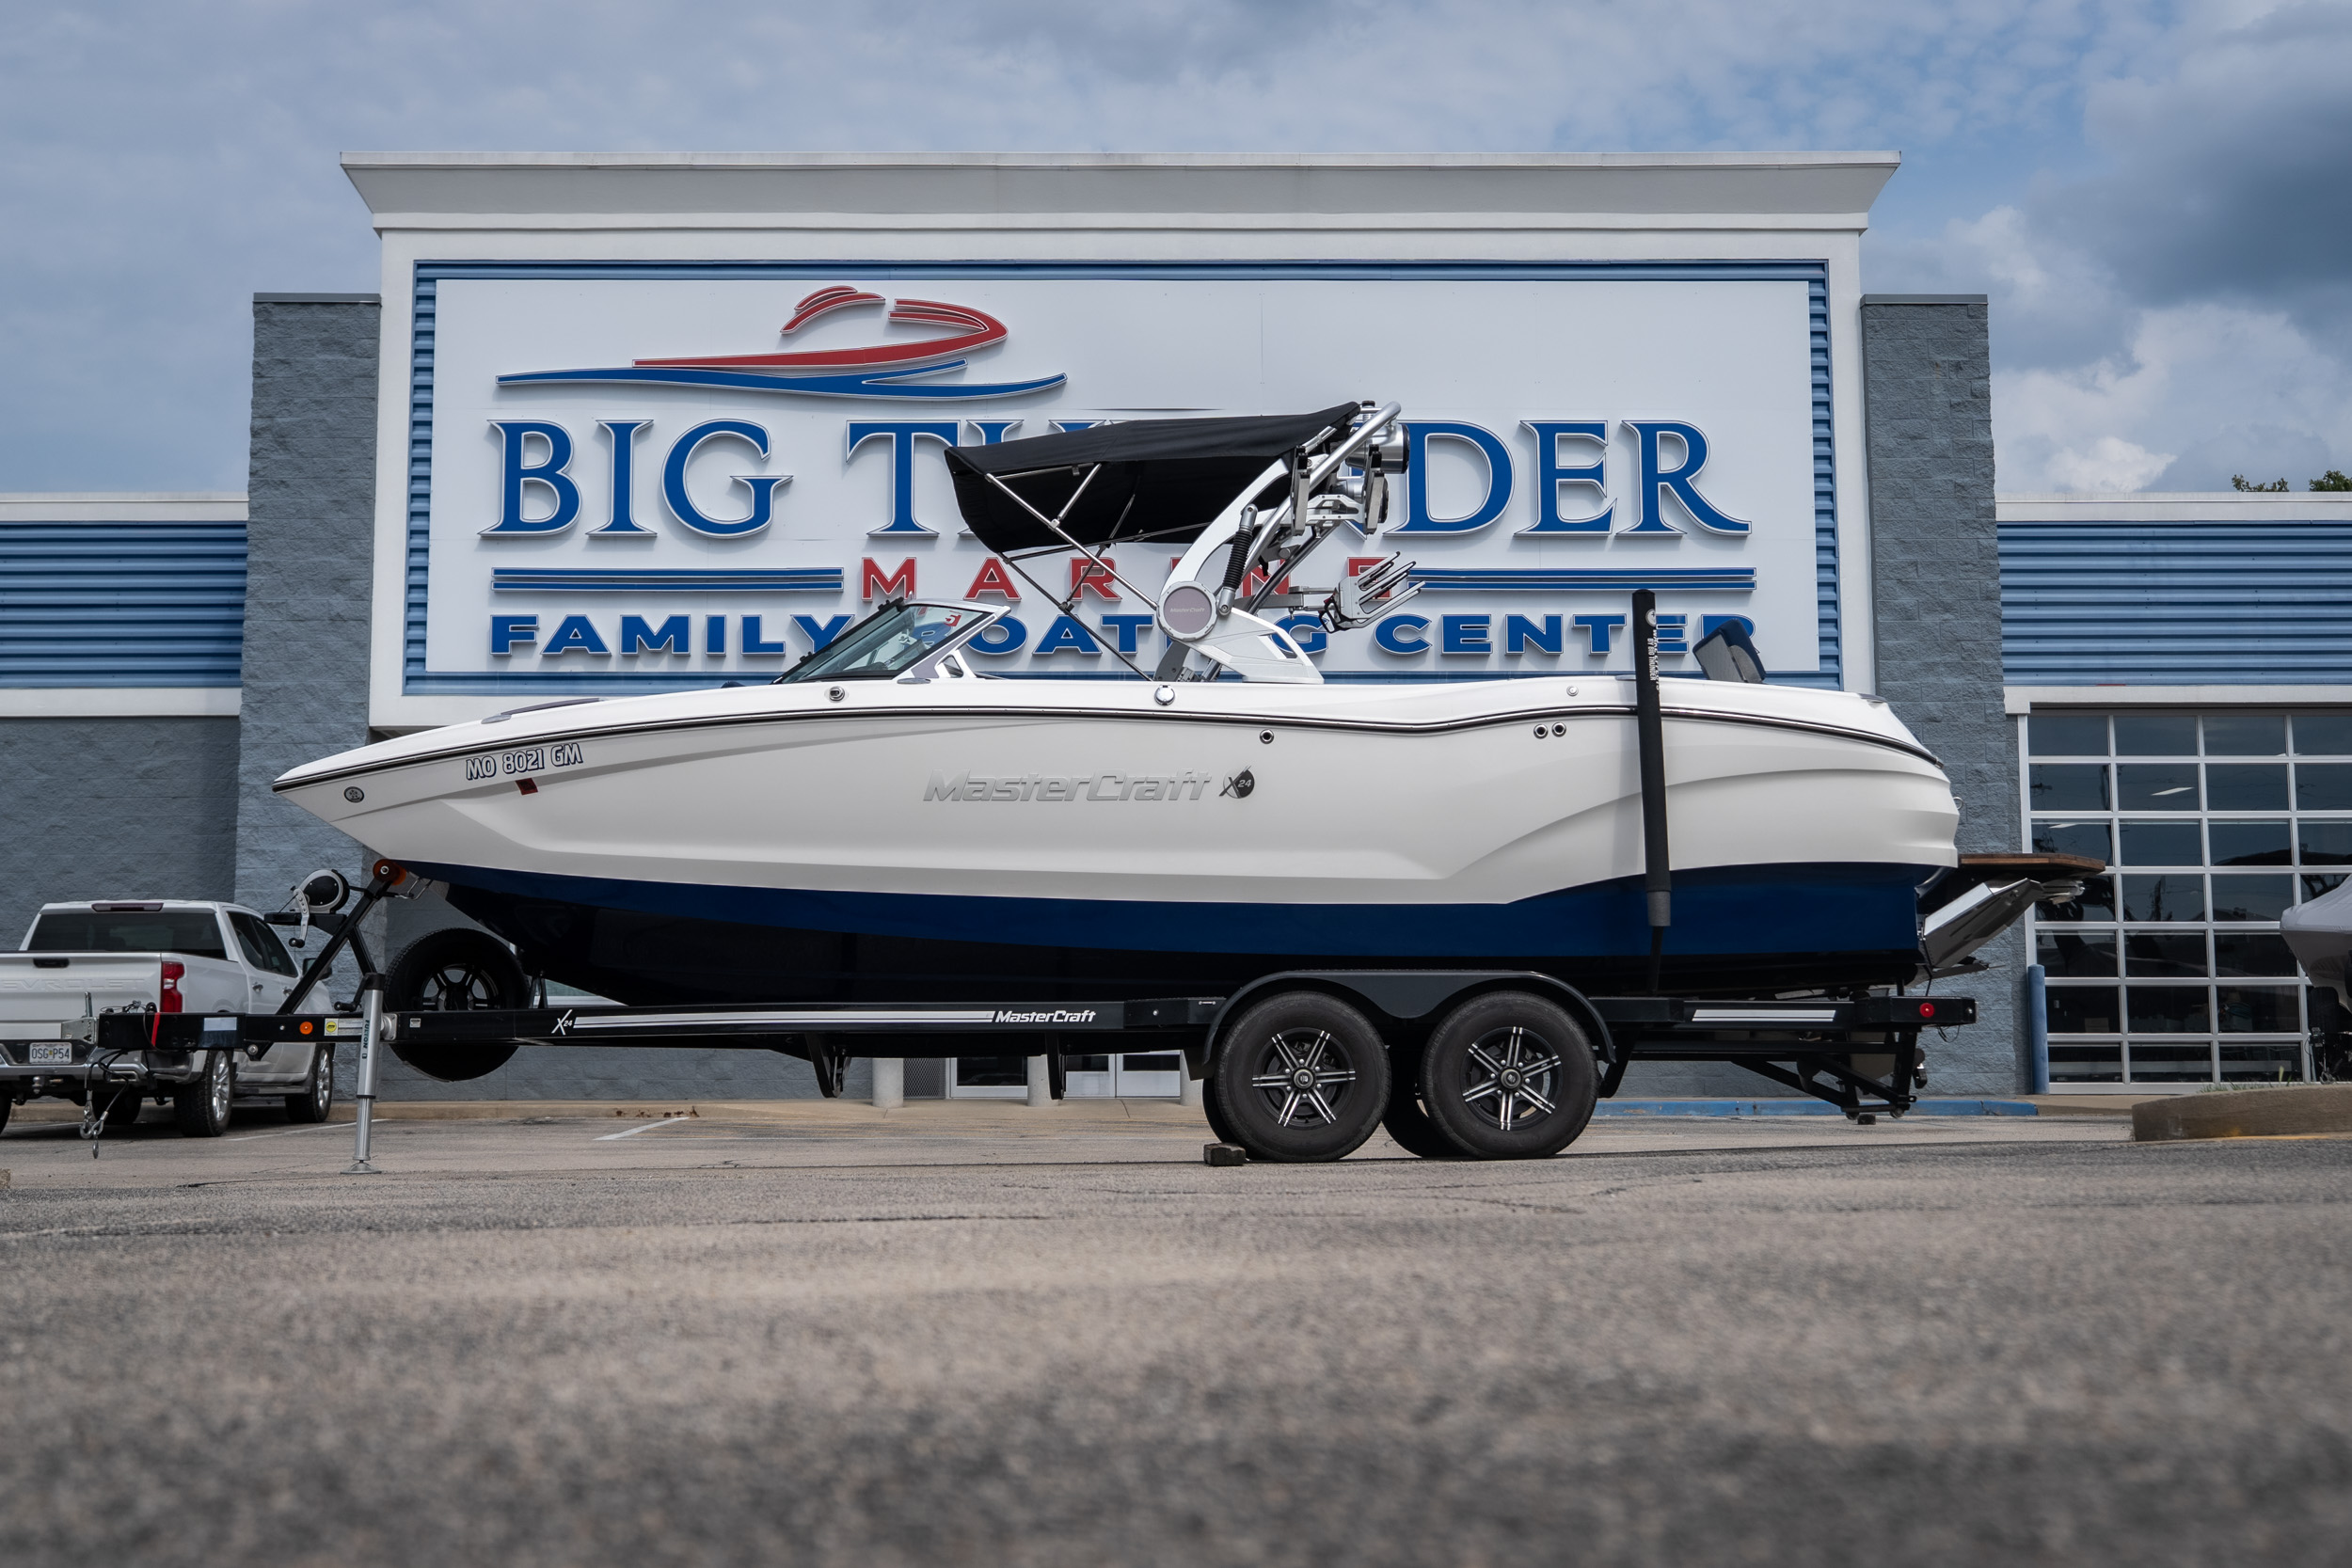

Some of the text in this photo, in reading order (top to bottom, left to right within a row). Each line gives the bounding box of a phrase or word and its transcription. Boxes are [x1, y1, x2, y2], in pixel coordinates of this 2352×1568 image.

[477, 419, 1752, 538] BIG TDER
[490, 613, 855, 656] FAMILY
[466, 742, 583, 780] MO 8021 GM
[923, 768, 1212, 801] MasterCraft
[995, 1009, 1096, 1022] MasterCraft
[53, 1048, 70, 1059] P54
